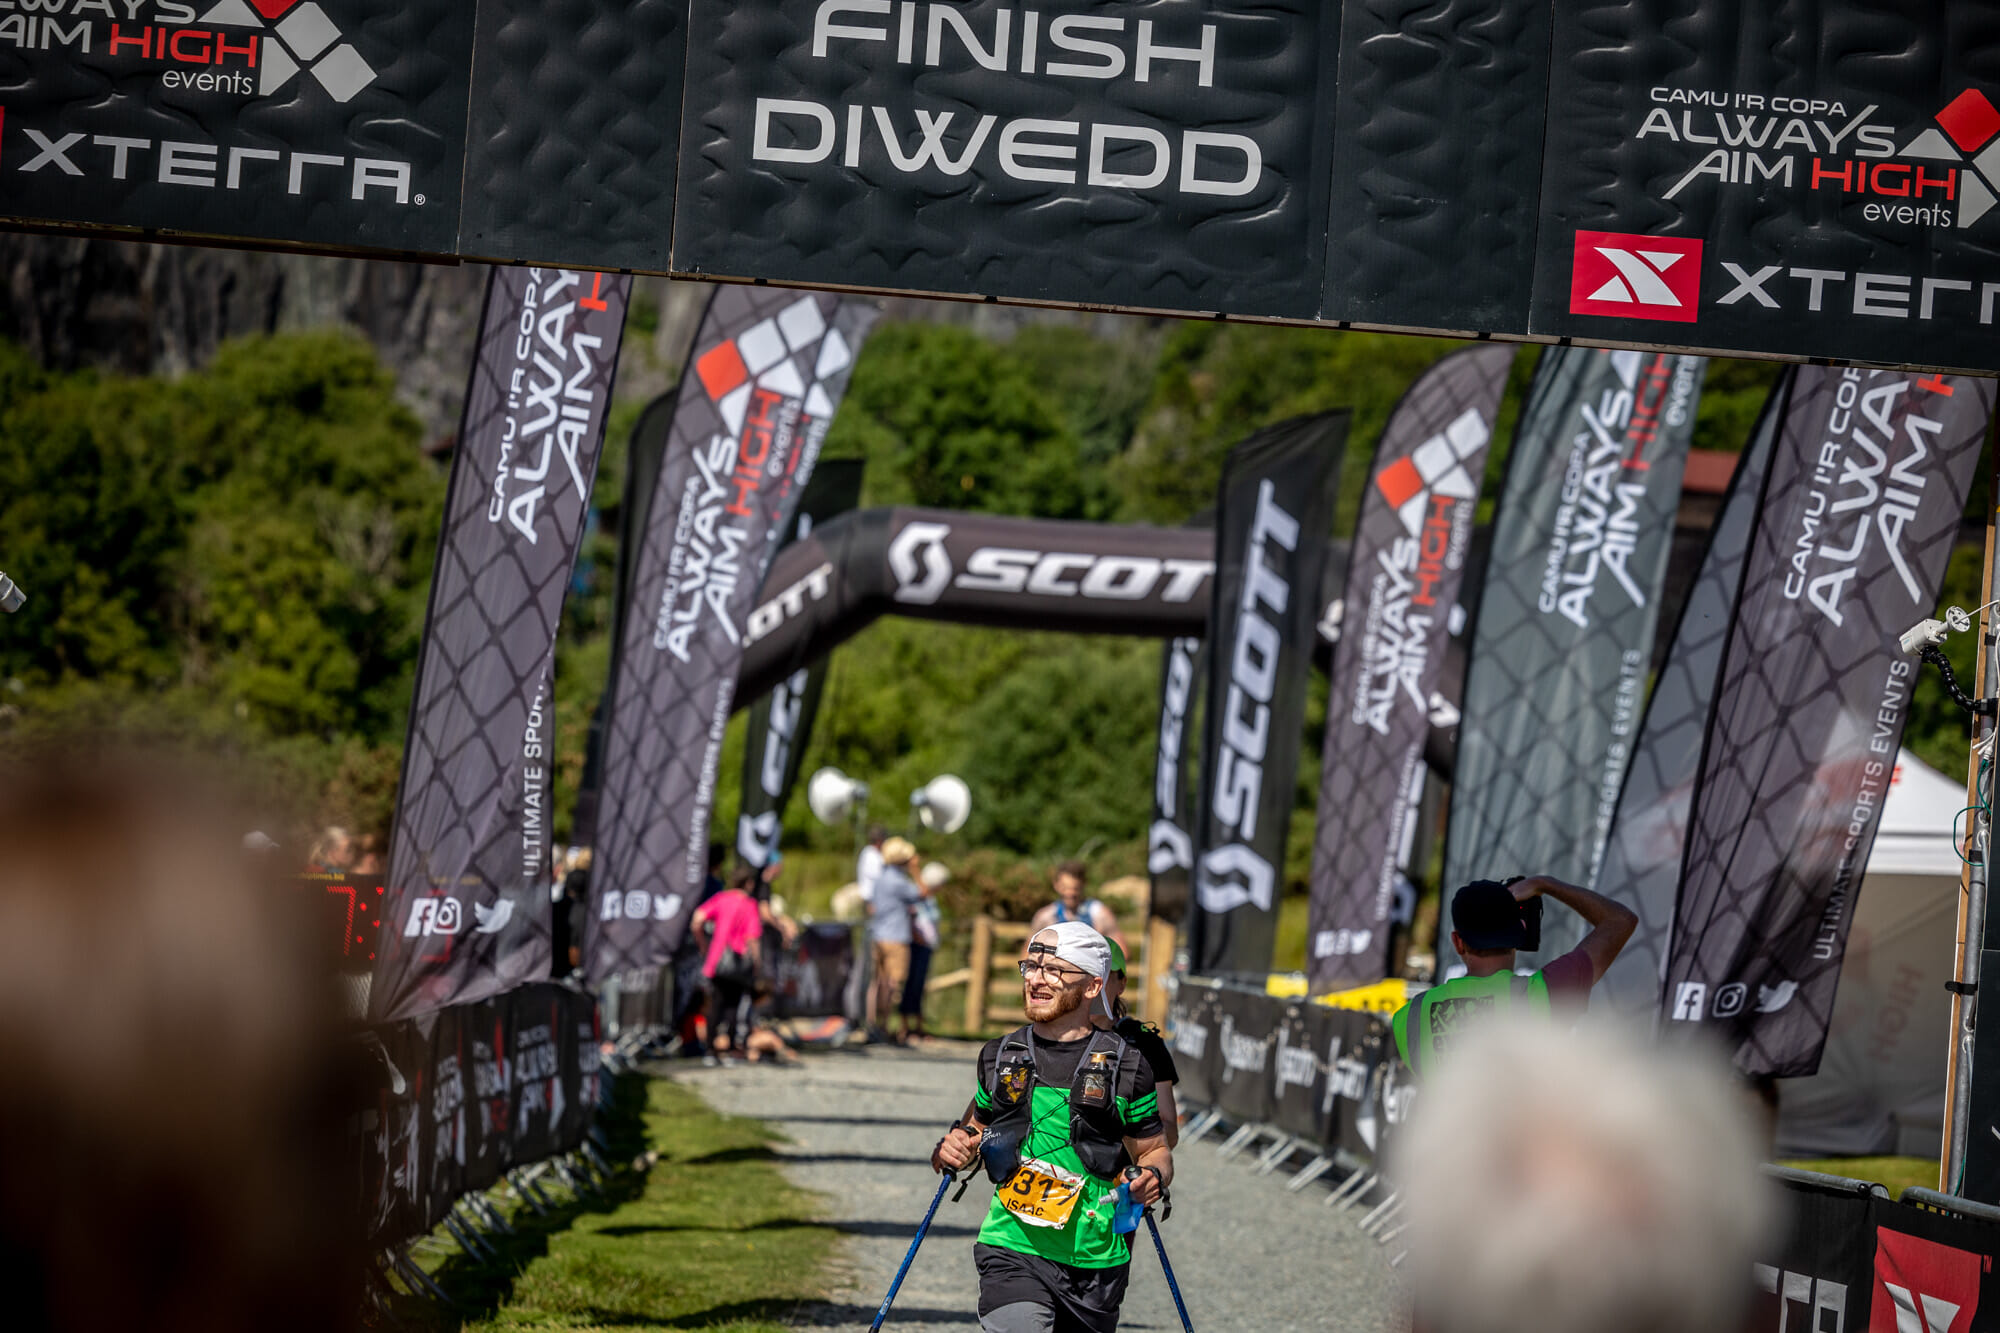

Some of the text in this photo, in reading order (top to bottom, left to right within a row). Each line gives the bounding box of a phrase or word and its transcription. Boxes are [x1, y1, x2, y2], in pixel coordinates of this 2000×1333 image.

[110, 23, 258, 68] HIGH
[162, 70, 253, 95] events
[811, 0, 1216, 87] FINISH
[1650, 87, 1848, 117] CAMU I'R COPA
[752, 97, 1263, 196] DIWEDD
[1635, 104, 1897, 158] ALWAYS
[1661, 149, 1957, 200] AIM HIGH
[1863, 202, 1951, 228] events
[488, 416, 516, 522] CAMU
[516, 268, 542, 360] COPA
[557, 332, 602, 501] AIM
[666, 434, 738, 664] ALWAYS
[704, 388, 781, 645] AIM HIGH
[1558, 389, 1633, 628] ALWAYS
[1600, 483, 1647, 608] AIM
[1784, 490, 1826, 599] CAMU
[1876, 414, 1943, 605] AIM
[1212, 477, 1300, 841] SCOTT
[1367, 537, 1420, 736] ALWAYS
[1400, 495, 1454, 713] AIM HIGH
[1843, 760, 1884, 852] SPORTS
[1870, 660, 1910, 755] EVENTS
[523, 766, 543, 877] ULTIMATE
[1006, 1198, 1044, 1217] ISAAC
